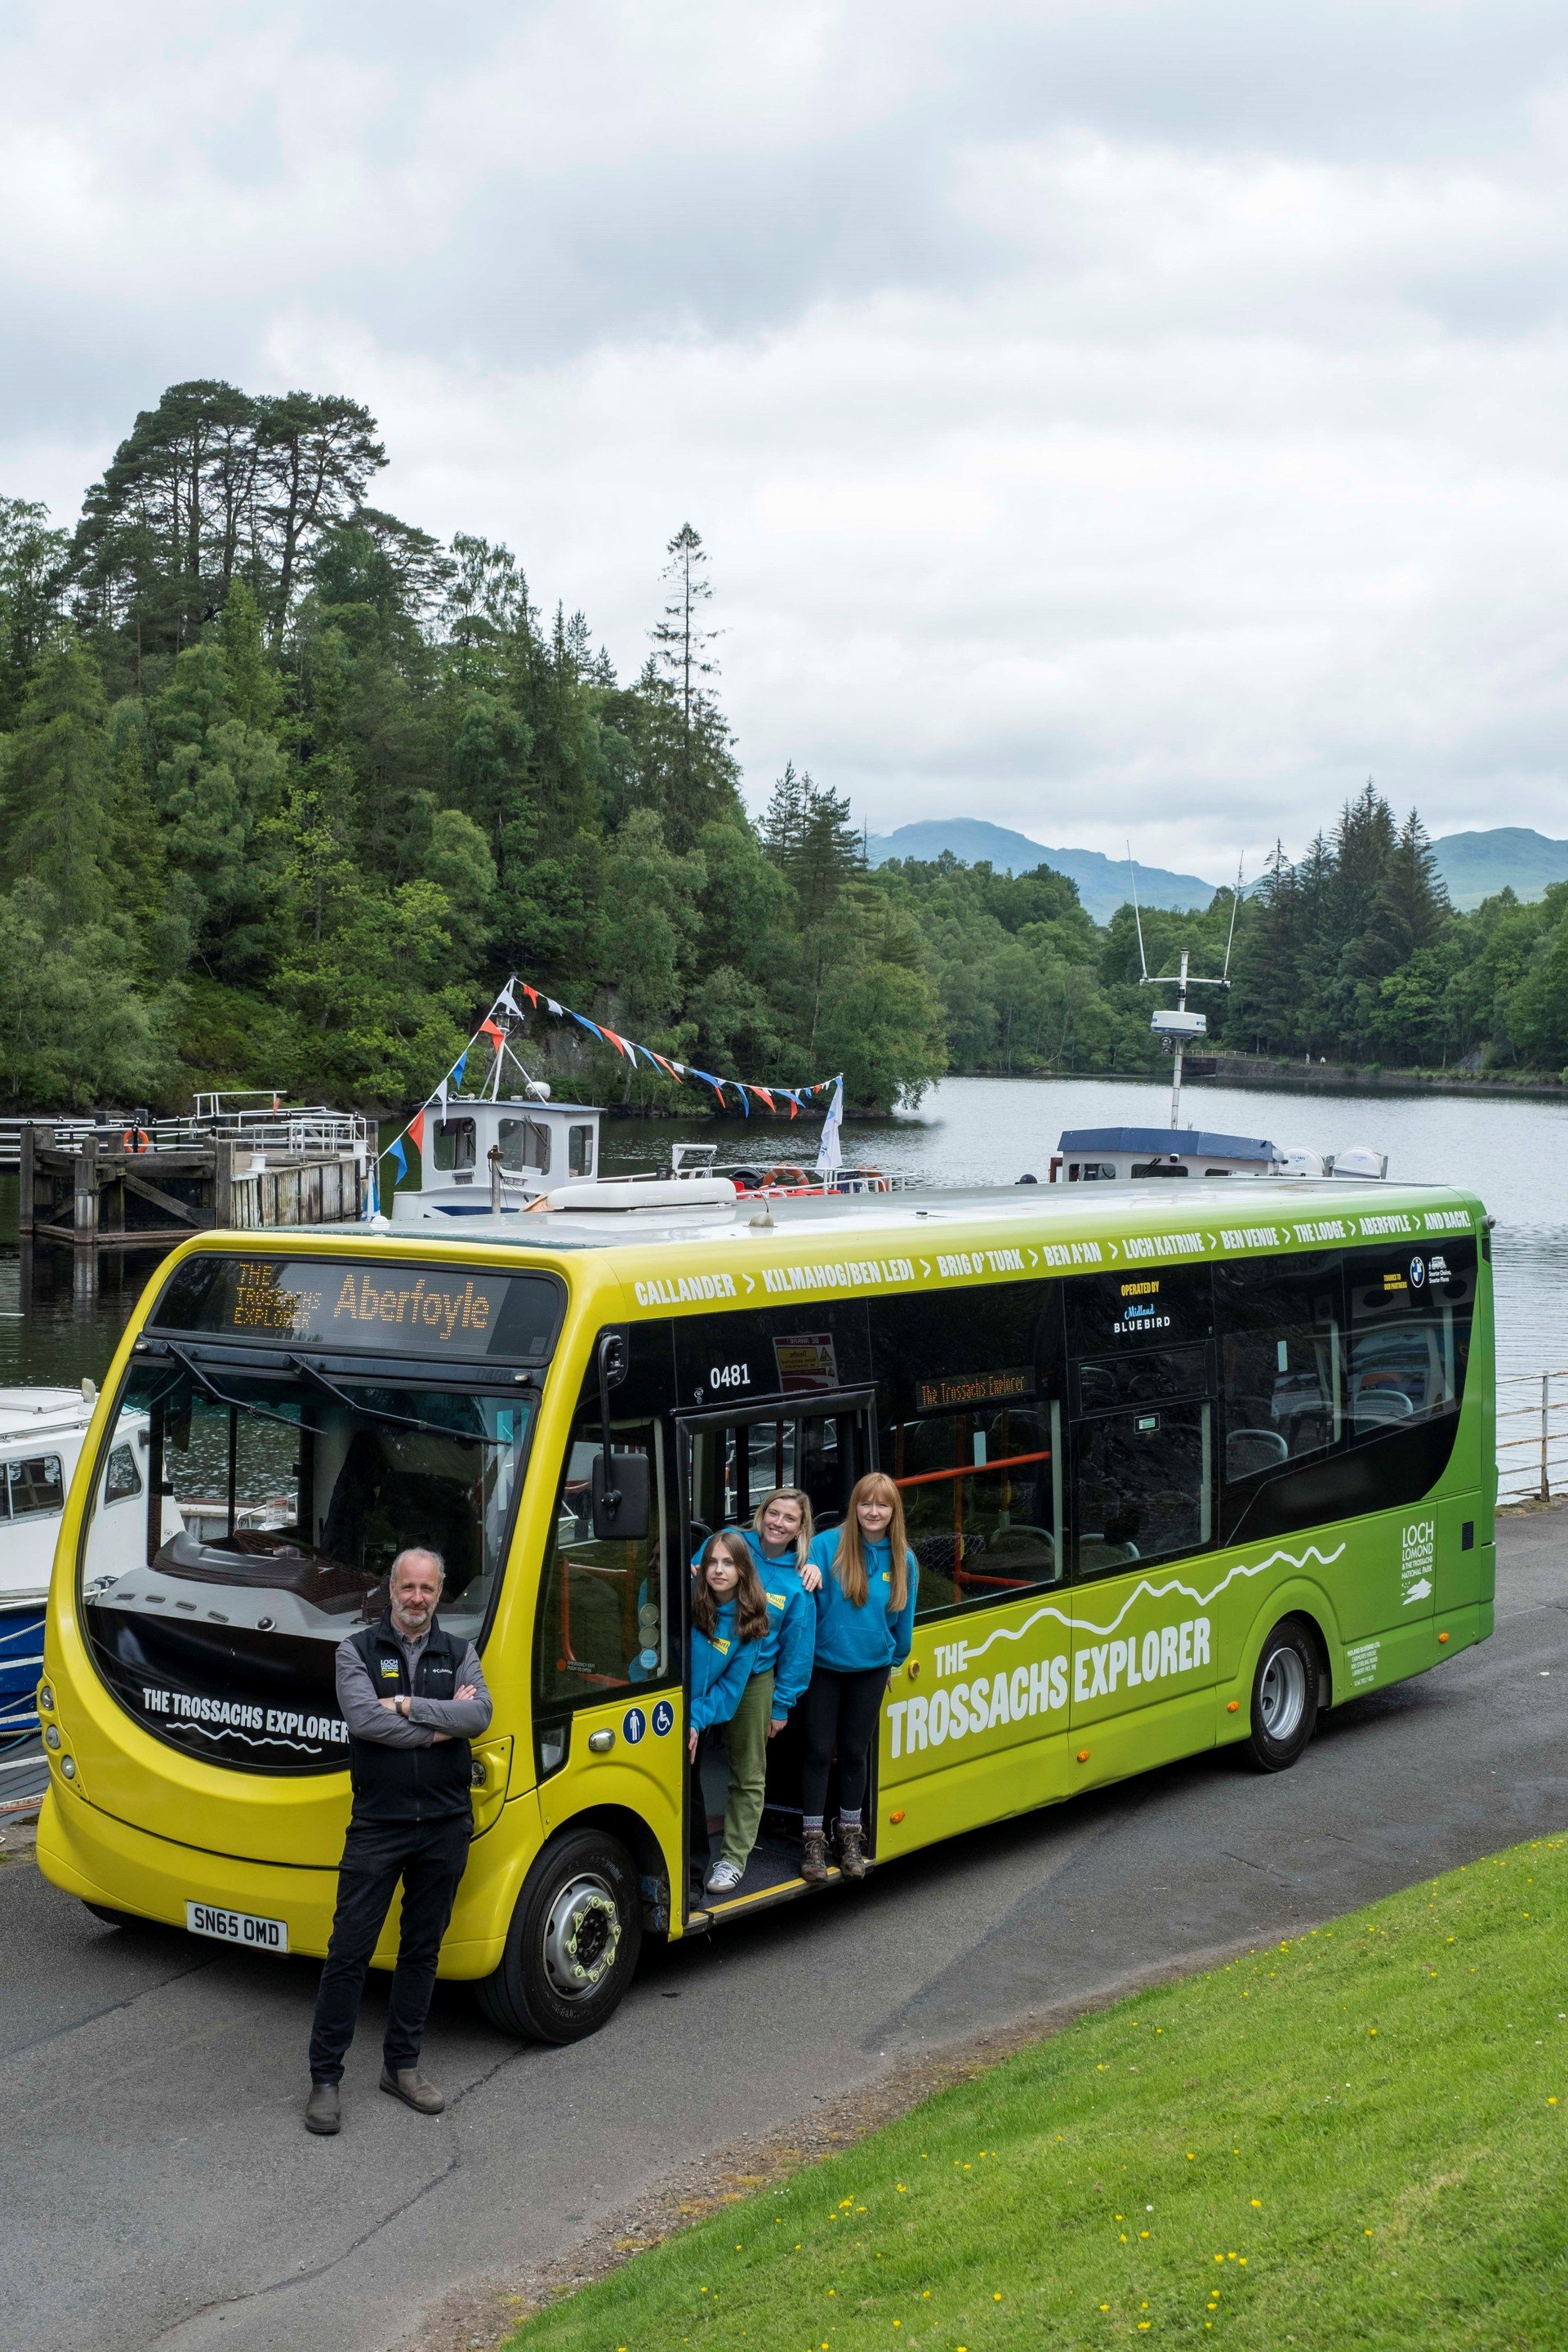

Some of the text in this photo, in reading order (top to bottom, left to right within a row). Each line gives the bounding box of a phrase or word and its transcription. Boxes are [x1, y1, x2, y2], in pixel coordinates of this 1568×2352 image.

[635, 1273, 737, 1307] CALLANDER
[762, 1261, 882, 1293] KILMAHOG/BEN
[880, 1258, 915, 1282] LEDI
[936, 1254, 973, 1277] BRIG
[986, 1249, 1025, 1272] TURK
[1043, 1245, 1071, 1267] BEN
[1122, 1238, 1155, 1259] LOCH
[1152, 1232, 1205, 1256] KATRINE
[1220, 1229, 1245, 1250] BEN
[1242, 1227, 1280, 1247] VENUE
[1293, 1223, 1316, 1242] THE
[1313, 1220, 1346, 1241] LODGE
[1359, 1214, 1412, 1236] ABERFOYLE
[1423, 1213, 1444, 1230] AND
[1442, 1210, 1471, 1227] BACK!
[239, 1263, 272, 1285] THE
[1121, 1281, 1160, 1296] OPERATED BY
[234, 1307, 310, 1329] EXPLORER
[333, 1274, 490, 1339] Aberfoyle
[1125, 1303, 1155, 1320] Midland
[1114, 1316, 1170, 1333] BLUEBIRD
[710, 1363, 751, 1388] 0481
[1402, 1521, 1434, 1548] LOCH
[1402, 1543, 1433, 1561] LOMOND
[1401, 1568, 1422, 1579] NATIONAL
[1405, 1561, 1413, 1570] THE
[933, 1640, 969, 1678] THE
[887, 1655, 1069, 1759] TROSSACHS
[1074, 1617, 1210, 1703] EXPLORER
[143, 1688, 350, 1744] THE TROSSACHS EXPLORER
[194, 1907, 279, 1946] SN65 OMD
